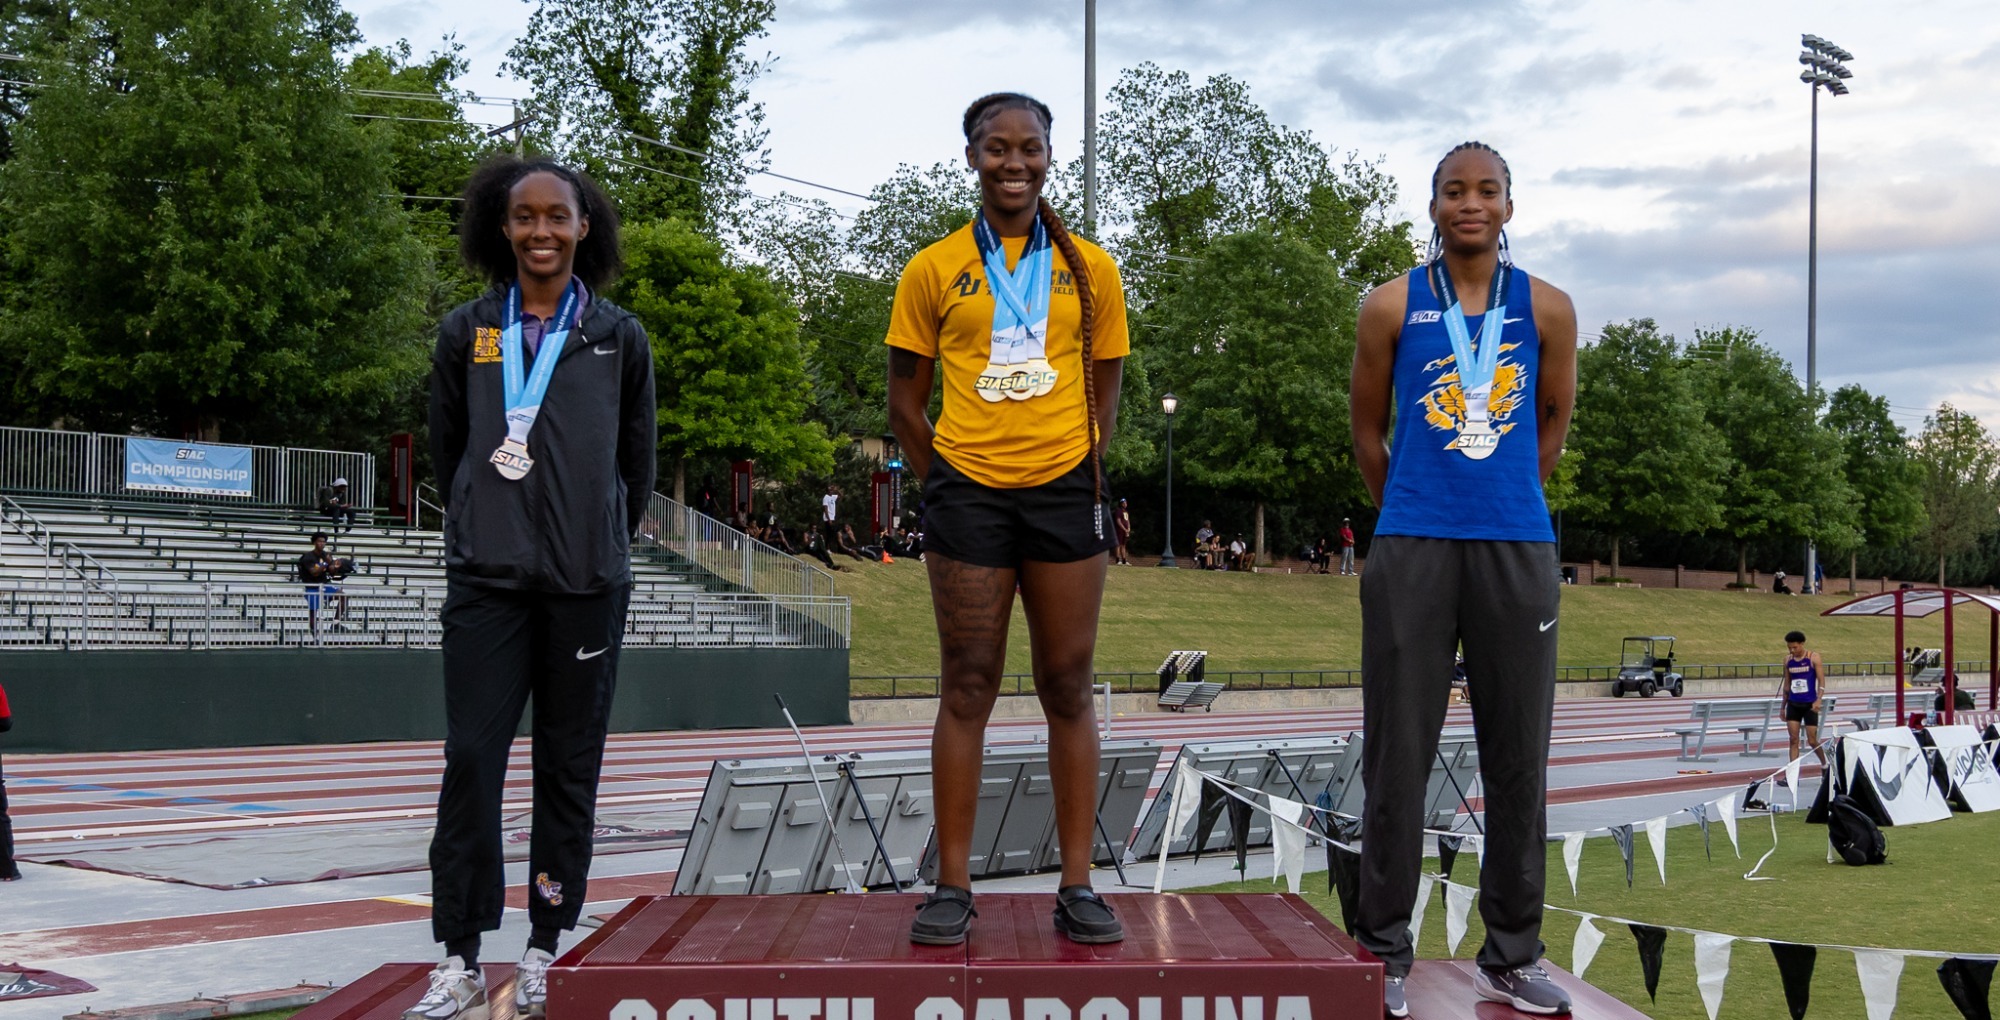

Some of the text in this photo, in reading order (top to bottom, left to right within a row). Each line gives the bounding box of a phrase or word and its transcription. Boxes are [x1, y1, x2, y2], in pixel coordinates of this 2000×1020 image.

[1411, 312, 1439, 321] SIAC
[1000, 374, 1039, 390] SIAC
[1457, 434, 1498, 448] SIAC
[176, 449, 206, 460] SIAC
[493, 451, 531, 472] SIAC
[130, 462, 248, 481] CHAMPIONSHIP
